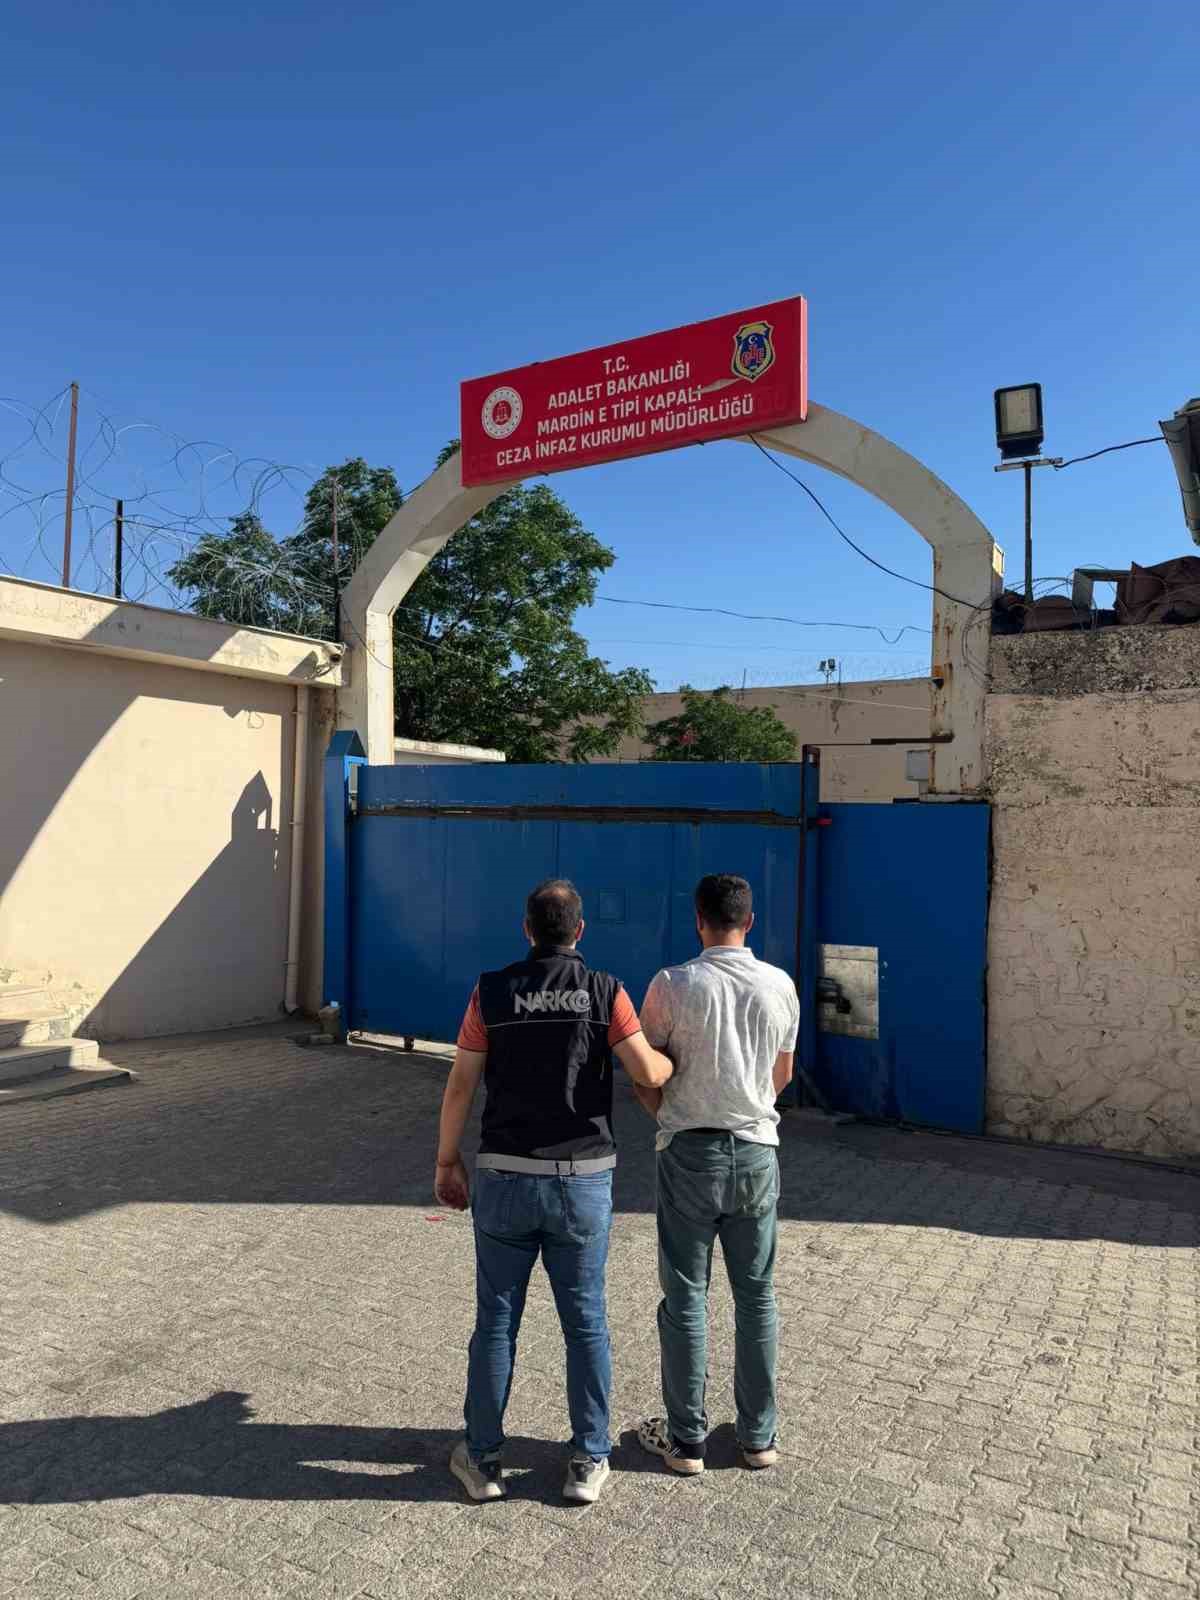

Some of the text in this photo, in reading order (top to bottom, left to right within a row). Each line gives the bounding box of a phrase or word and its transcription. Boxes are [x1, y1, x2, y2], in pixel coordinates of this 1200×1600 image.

[548, 359, 690, 410] ADALET BAKANLIĞI
[603, 356, 630, 375] T.C.
[496, 393, 753, 466] CEZA İNFAZ KURUMU MÜDÜRLÜĞÜ
[536, 407, 594, 436] MARDİN
[599, 406, 607, 423] E
[611, 395, 640, 420] TİPİ
